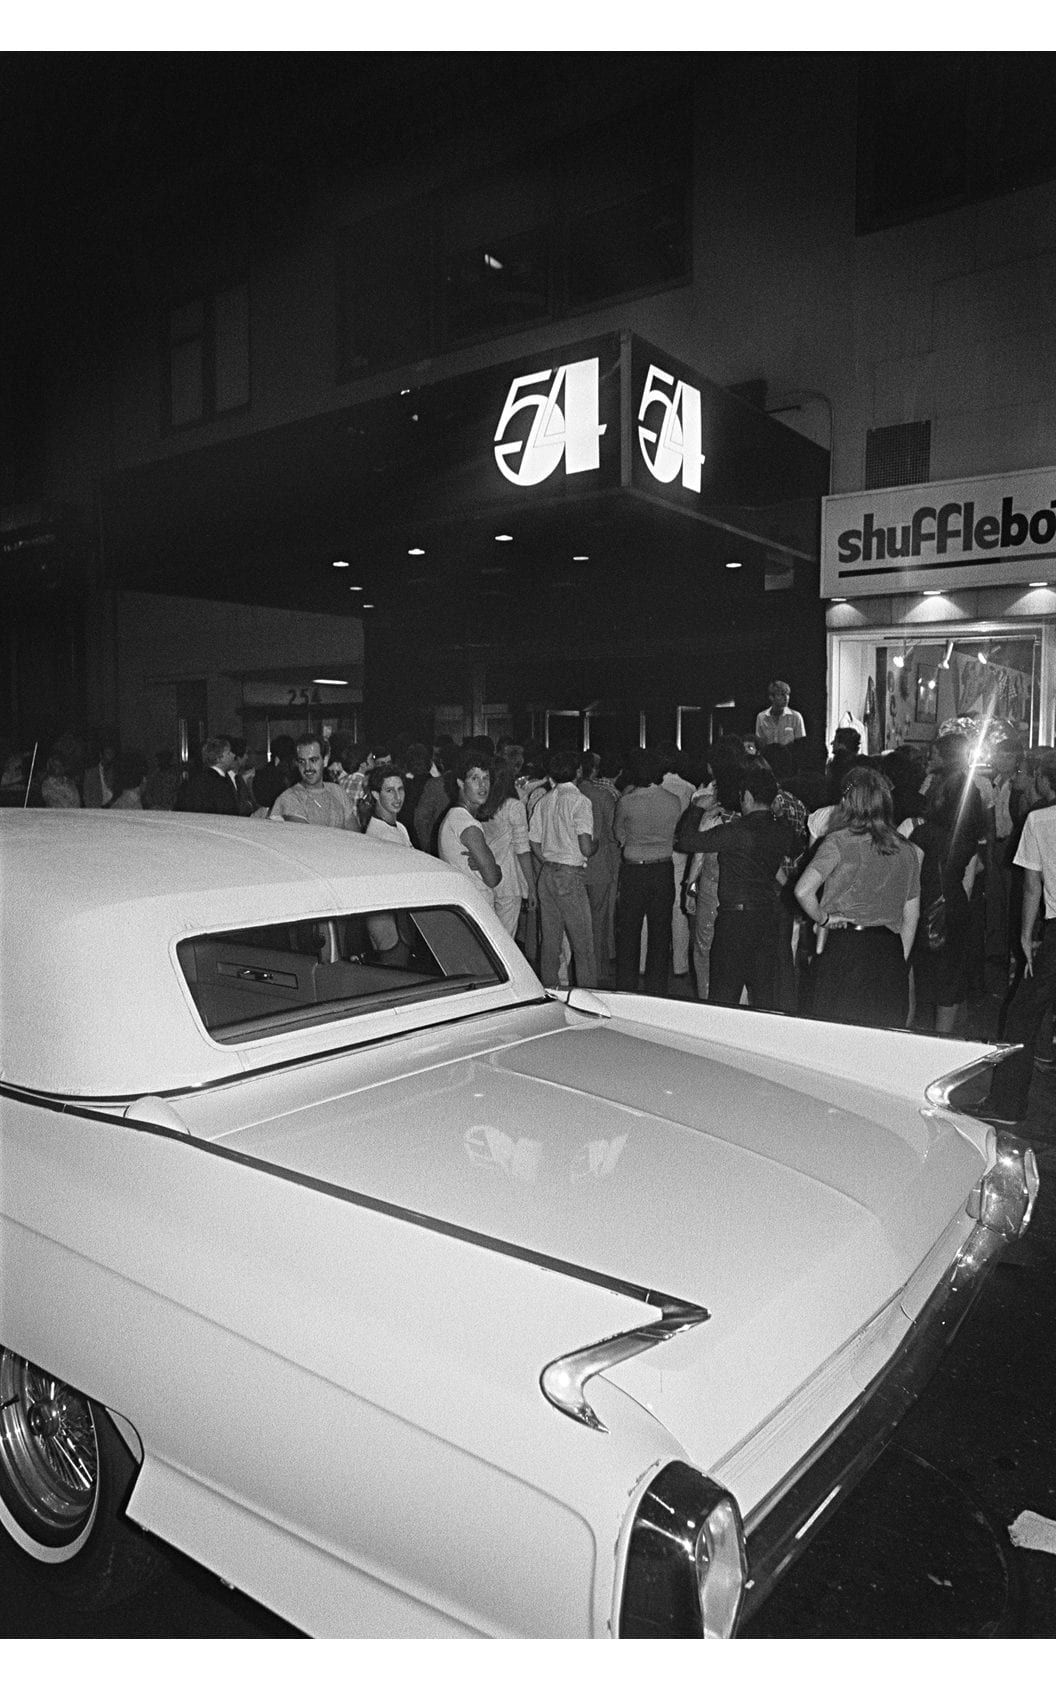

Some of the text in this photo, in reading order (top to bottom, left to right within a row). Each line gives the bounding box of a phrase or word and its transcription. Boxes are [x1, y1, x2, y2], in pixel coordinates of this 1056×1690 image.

[493, 357, 607, 486] 54
[638, 364, 706, 494] 54
[837, 497, 1056, 564] shufflebo
[287, 688, 322, 707] 254
